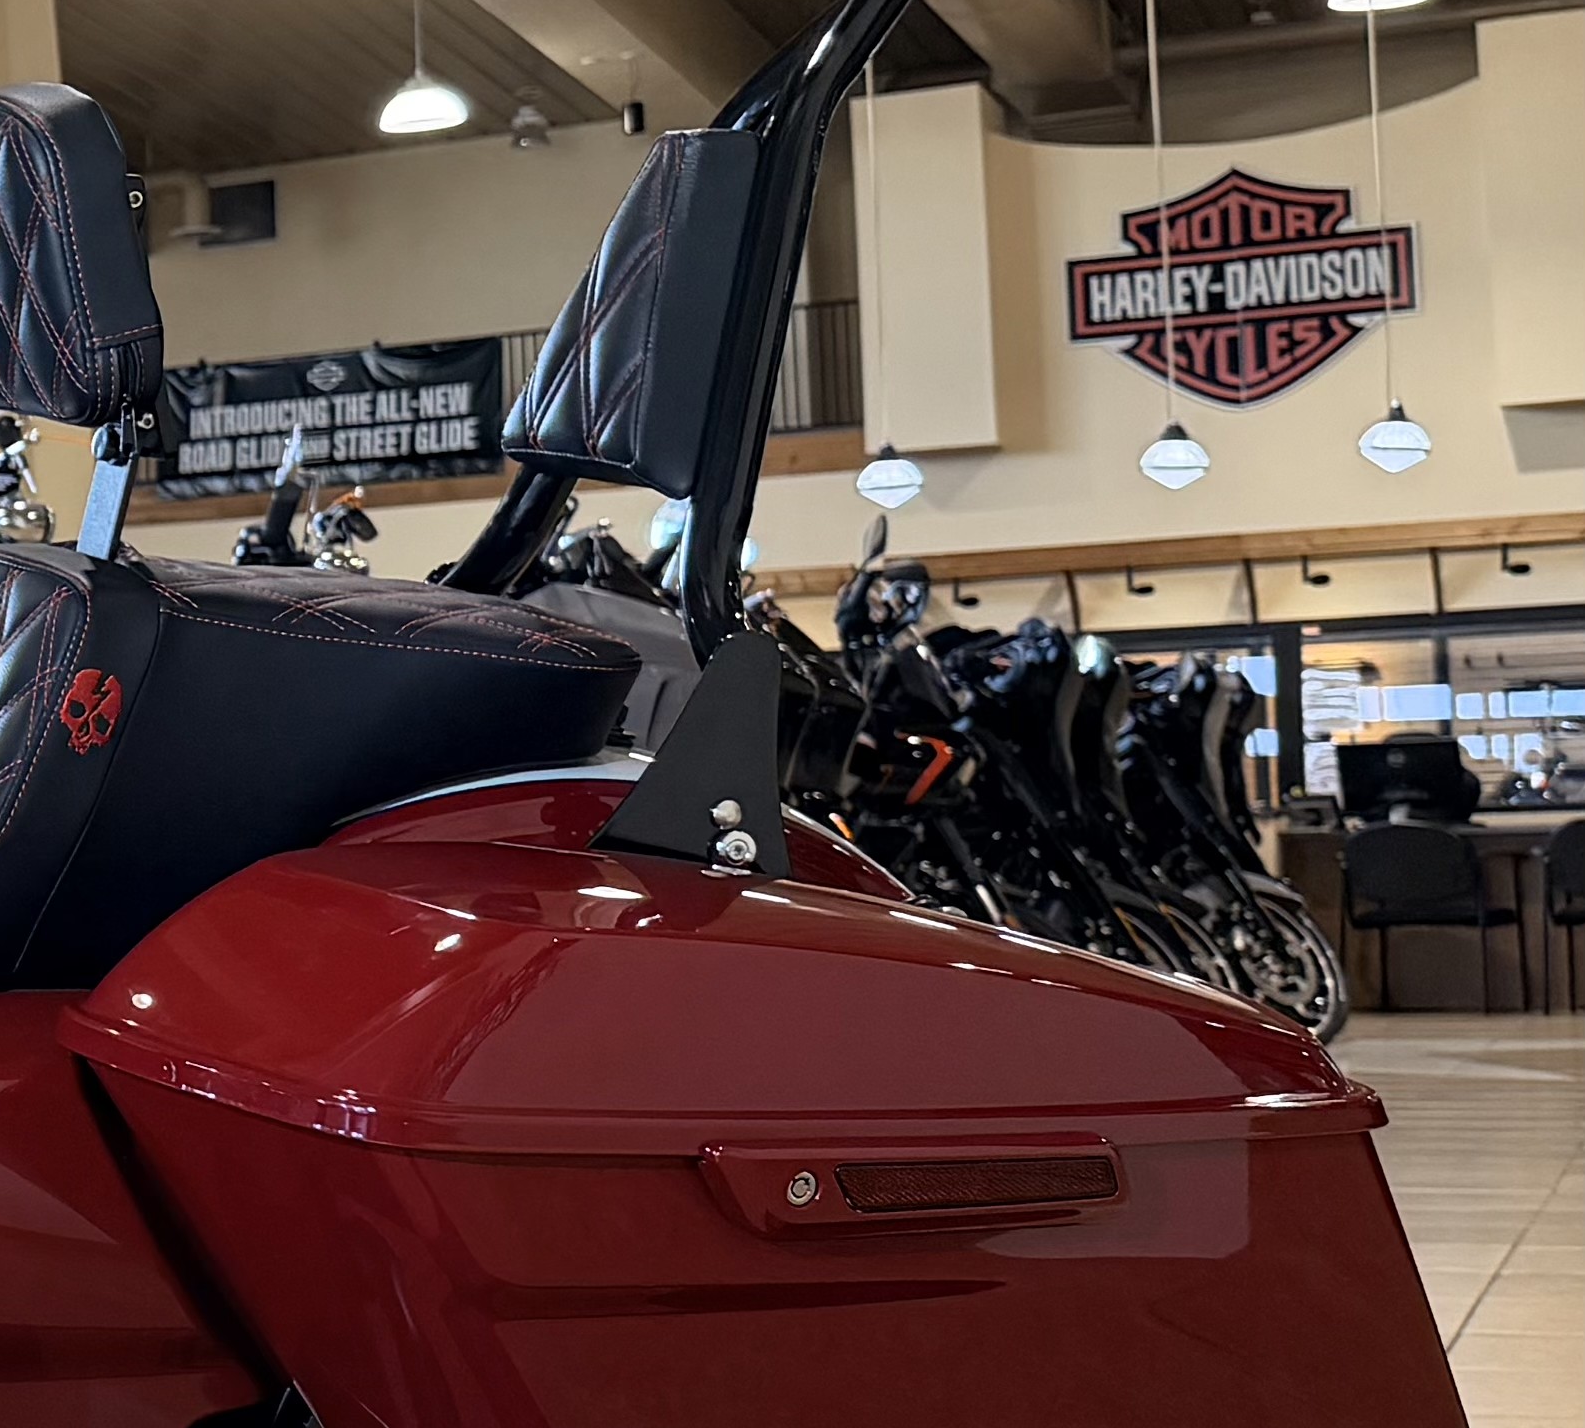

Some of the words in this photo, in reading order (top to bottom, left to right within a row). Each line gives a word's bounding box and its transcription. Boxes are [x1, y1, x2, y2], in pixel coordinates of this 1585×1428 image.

[1157, 189, 1318, 253] MOTOR
[1088, 245, 1388, 324] HARLEY-DAVIDSON
[1162, 318, 1324, 388] CYCLES
[189, 397, 329, 440] INTRODUCING
[333, 391, 374, 424] THE
[375, 382, 472, 422] ALL-NEW
[180, 440, 230, 474] ROAD
[234, 434, 283, 470] GLID
[332, 424, 413, 463] STREET
[415, 417, 480, 454] GLIDE
